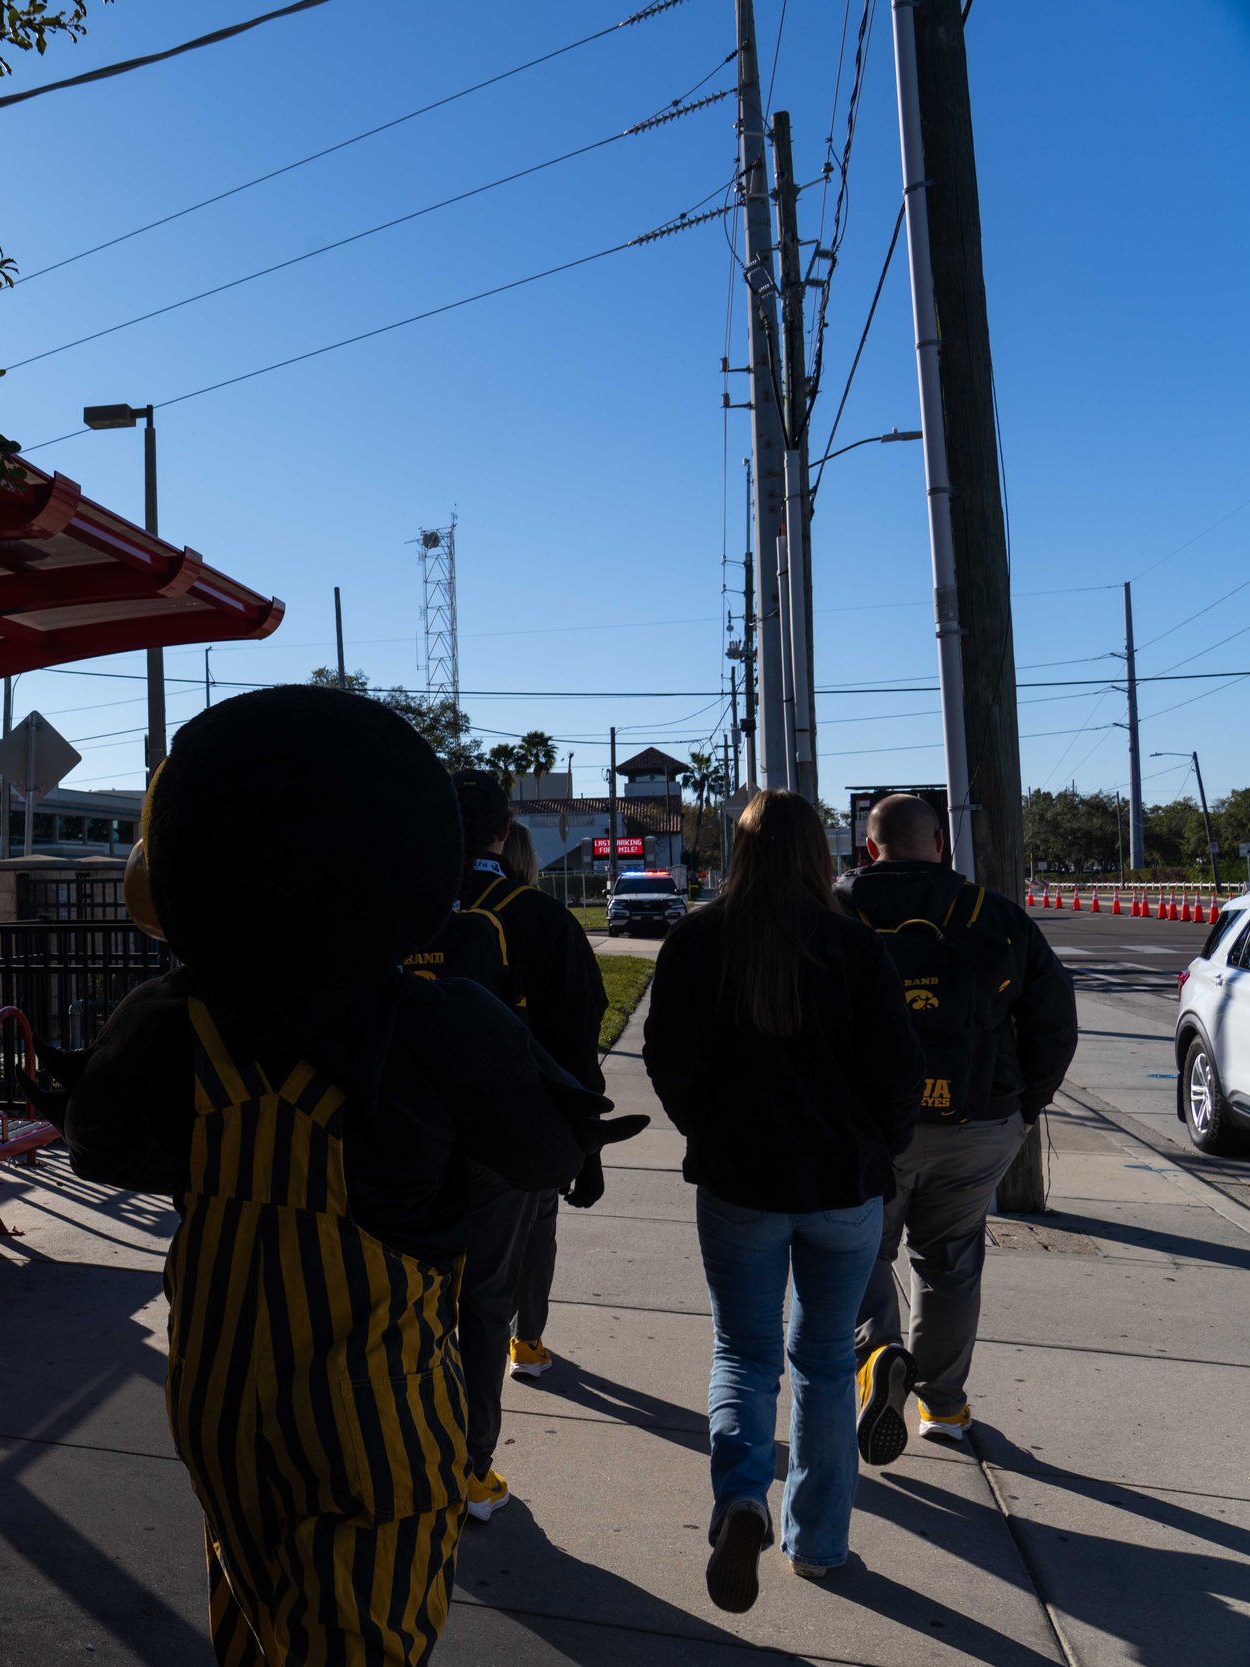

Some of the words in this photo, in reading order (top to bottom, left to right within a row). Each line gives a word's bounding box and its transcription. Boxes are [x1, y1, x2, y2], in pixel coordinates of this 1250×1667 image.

[594, 839, 610, 847] LAST
[402, 952, 445, 966] BAND
[903, 976, 939, 987] BAND
